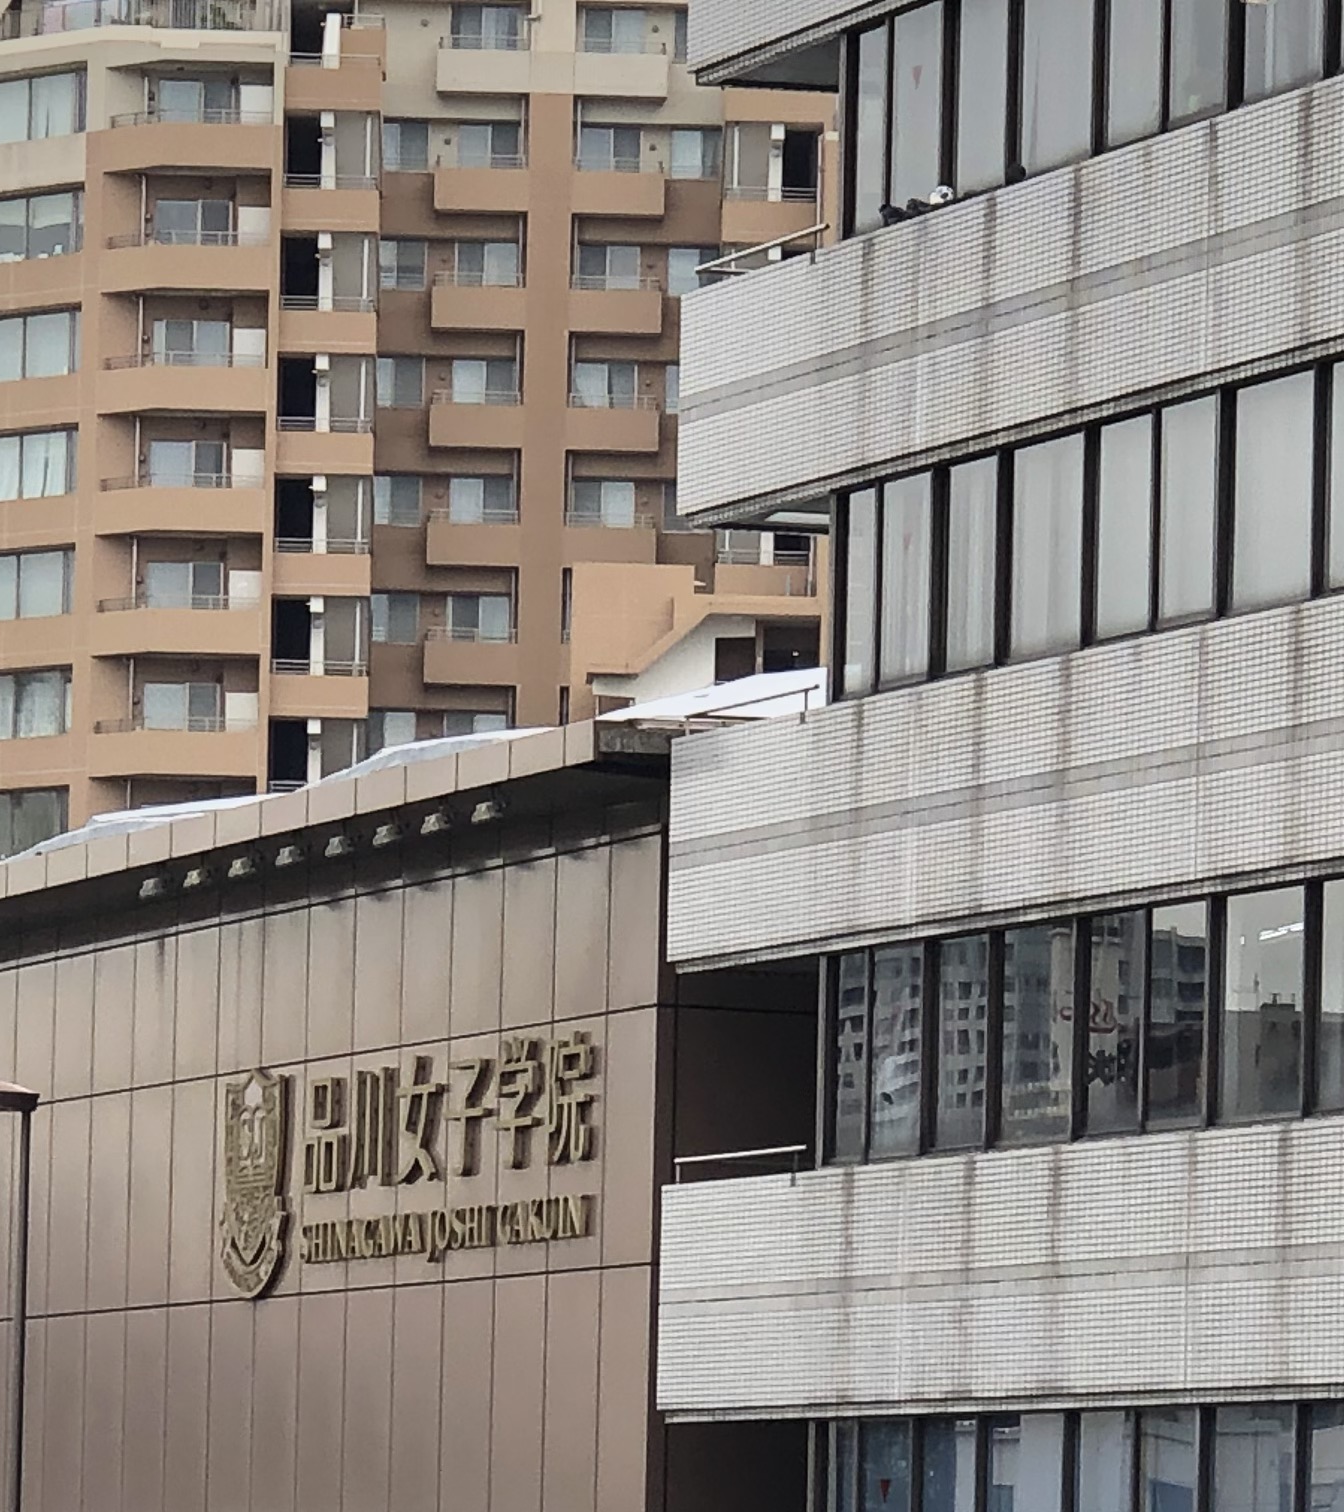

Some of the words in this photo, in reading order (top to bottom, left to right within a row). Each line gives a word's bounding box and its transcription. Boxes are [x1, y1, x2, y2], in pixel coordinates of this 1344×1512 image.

[302, 1031, 600, 1192] 品川女子学院
[301, 1214, 426, 1264] SHINAGAWA
[427, 1203, 492, 1263] JOSHI
[497, 1195, 590, 1245] GAKUIN
